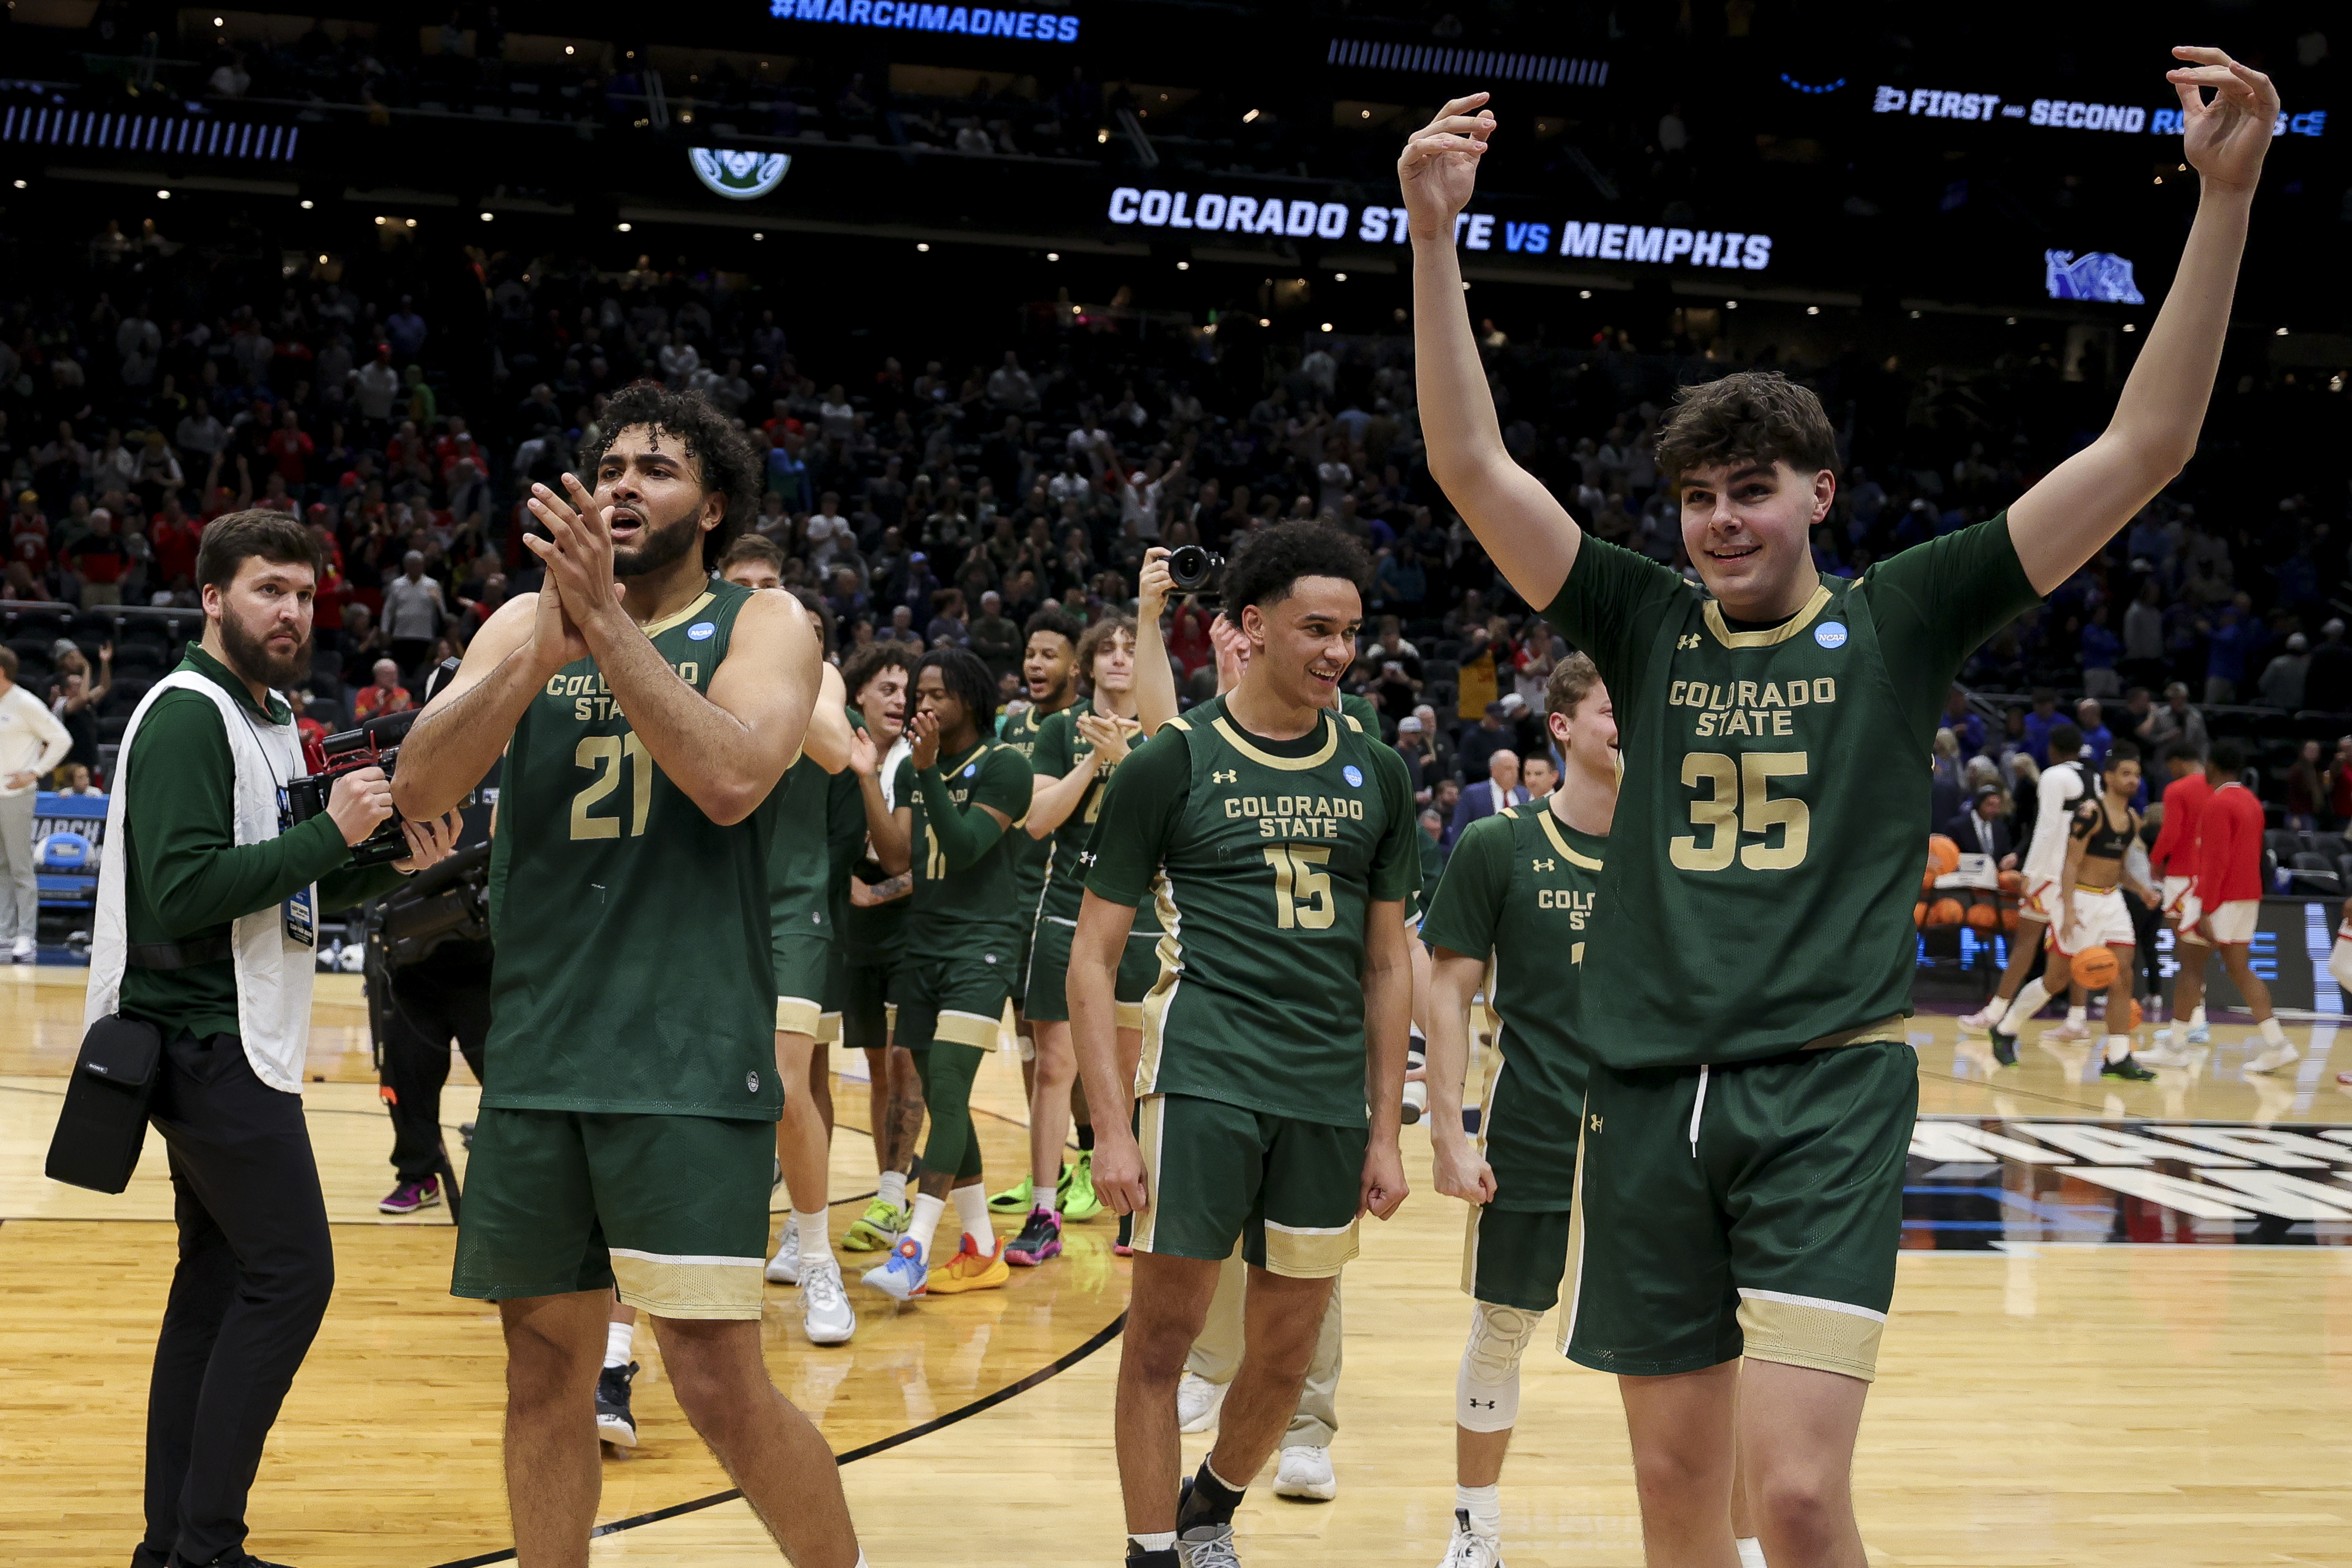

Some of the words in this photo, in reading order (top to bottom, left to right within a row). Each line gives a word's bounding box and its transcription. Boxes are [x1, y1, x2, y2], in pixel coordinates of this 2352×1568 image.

[769, 0, 1080, 43] #MARCHMADNESS
[1909, 88, 2001, 121] FIRST
[2029, 99, 2146, 133] SECOND
[1108, 187, 1349, 240] COLORADO
[1359, 205, 1495, 251] STTE
[1505, 221, 1552, 254] VS
[1559, 221, 1773, 270] MEMPHIS
[575, 697, 625, 721] STA
[1669, 677, 1836, 710] COLORADO
[1695, 709, 1794, 736] STATE
[570, 730, 653, 840] 21
[1224, 795, 1363, 821] COLORADO
[1669, 751, 1810, 872] 35
[1259, 818, 1337, 838] STATE
[1263, 843, 1335, 930] 15
[89, 1063, 105, 1073] SONY
